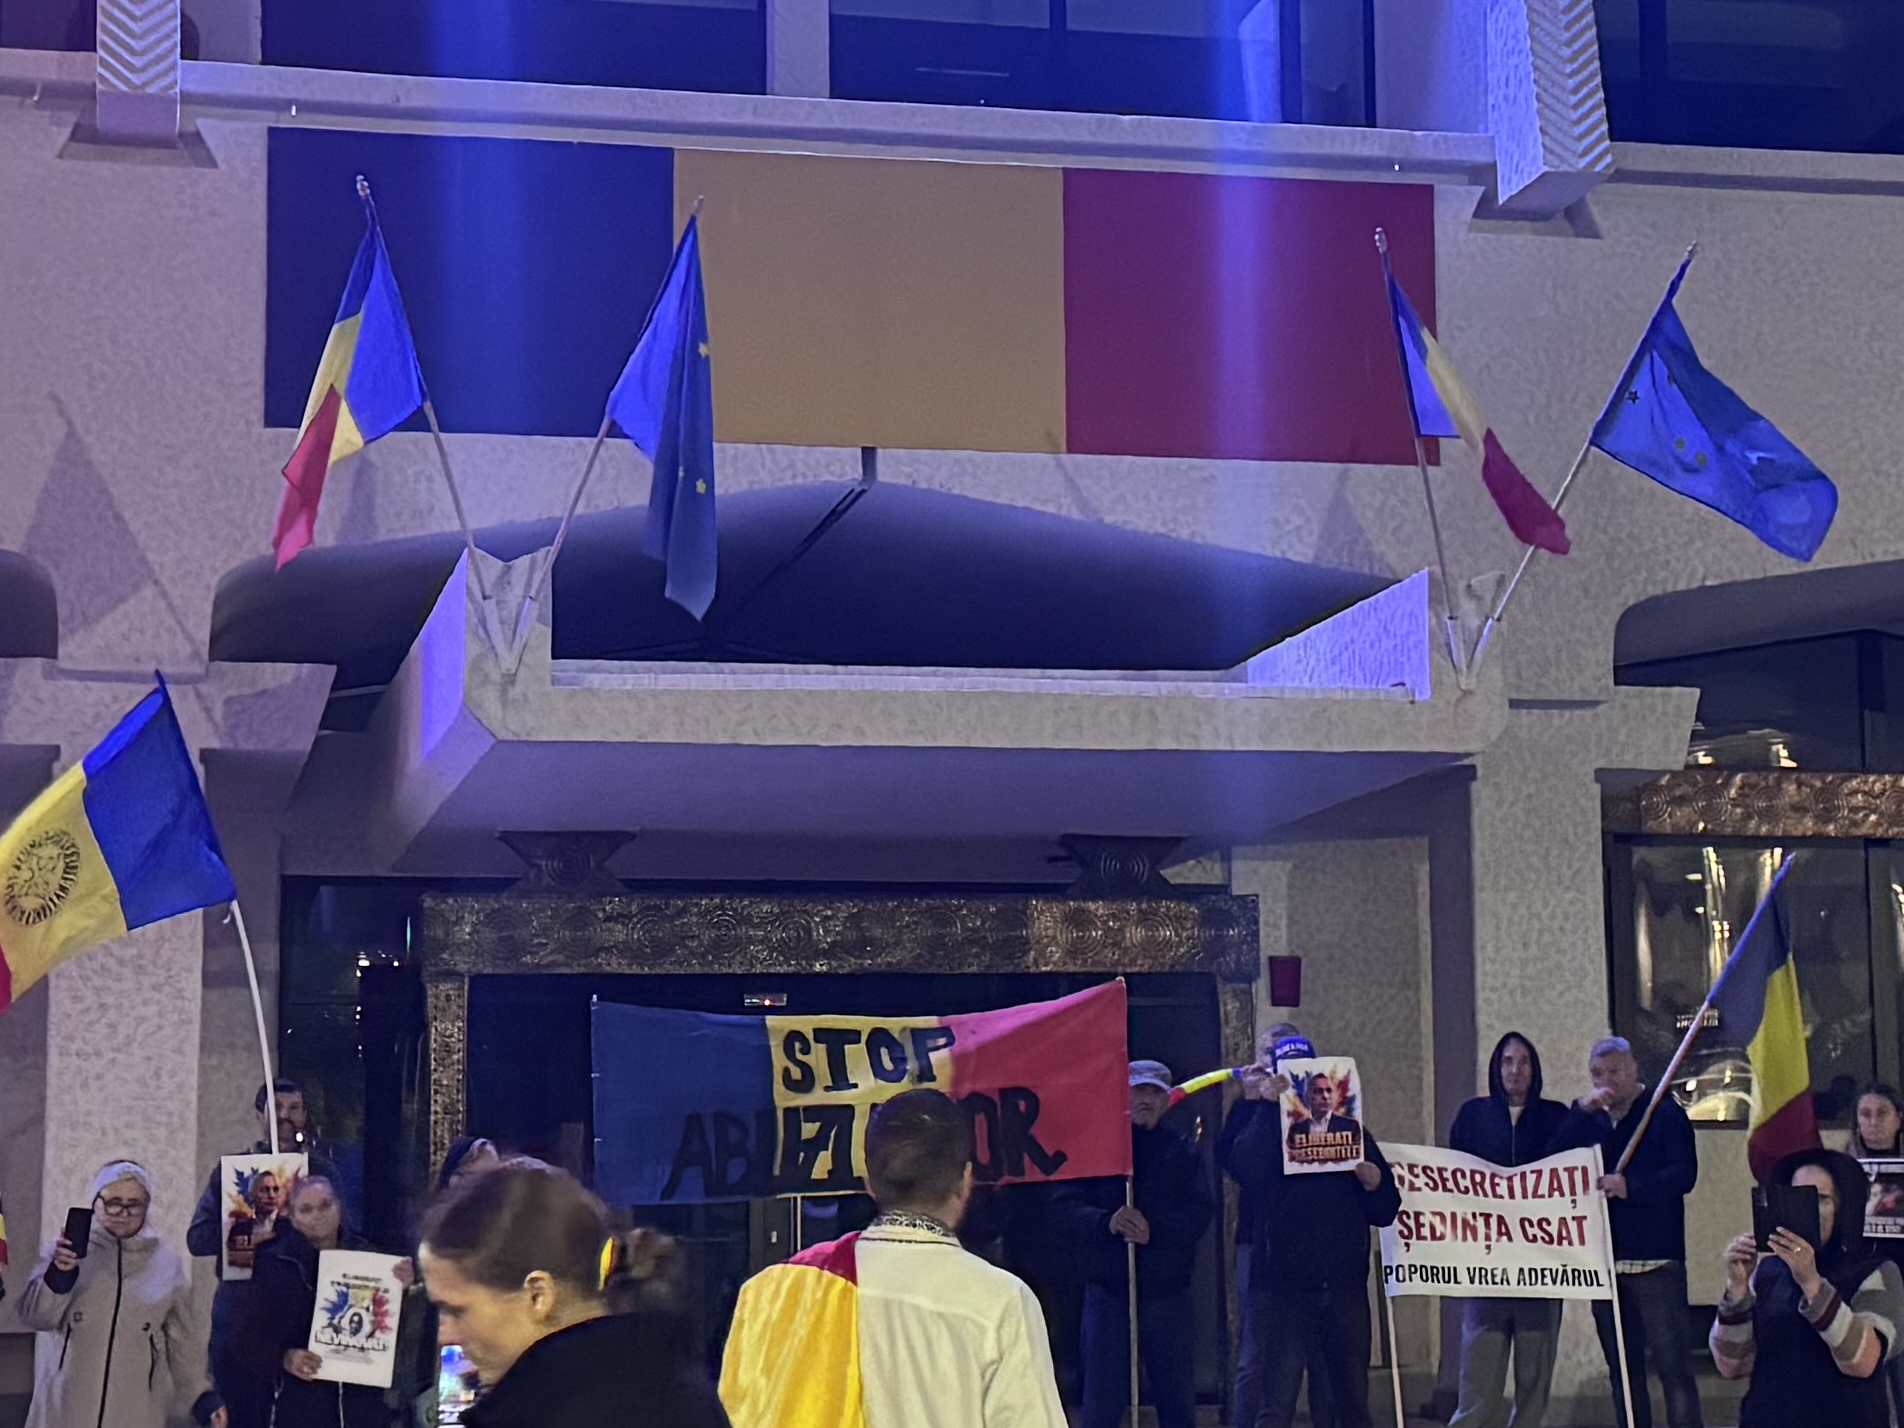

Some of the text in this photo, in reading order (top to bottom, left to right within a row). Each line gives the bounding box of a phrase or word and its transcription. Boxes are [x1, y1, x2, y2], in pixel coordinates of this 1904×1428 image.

[782, 1026, 956, 1093] STOP
[1519, 1215, 1588, 1247] CSAT
[1384, 1263, 1605, 1288] POPORUL VREA ADEVĂRUL
